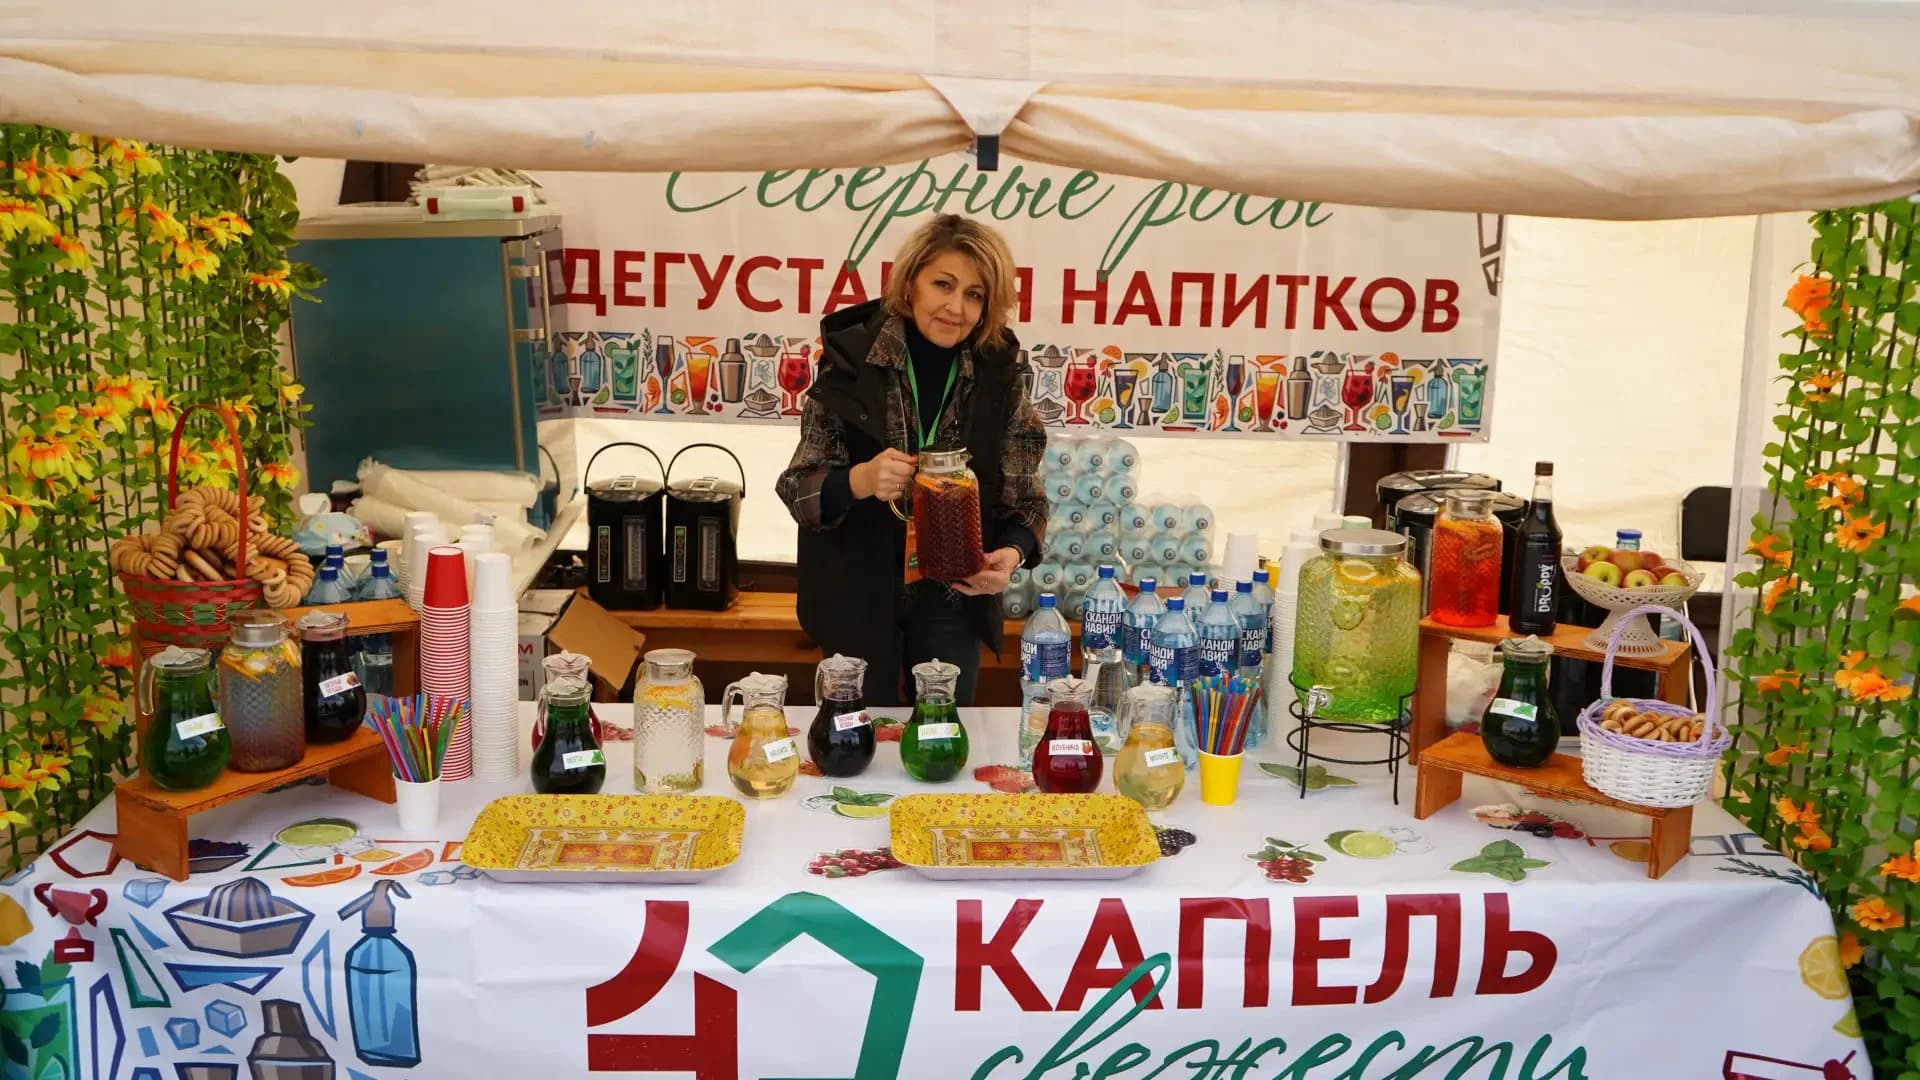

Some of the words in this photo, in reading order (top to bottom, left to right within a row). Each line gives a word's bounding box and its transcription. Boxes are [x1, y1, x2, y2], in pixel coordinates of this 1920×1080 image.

[563, 247, 1034, 325] ДЕГУСТА
[1061, 268, 1460, 334] НАПИТКОВ
[1085, 611, 1122, 625] СКАНДИ
[1085, 621, 1116, 635] НАВИЯ
[1200, 638, 1234, 651] КАНДИ
[1151, 645, 1175, 660] АНДИ
[1200, 649, 1228, 662] АВИЯ
[955, 892, 1558, 1012] КАПЕЛЬ
